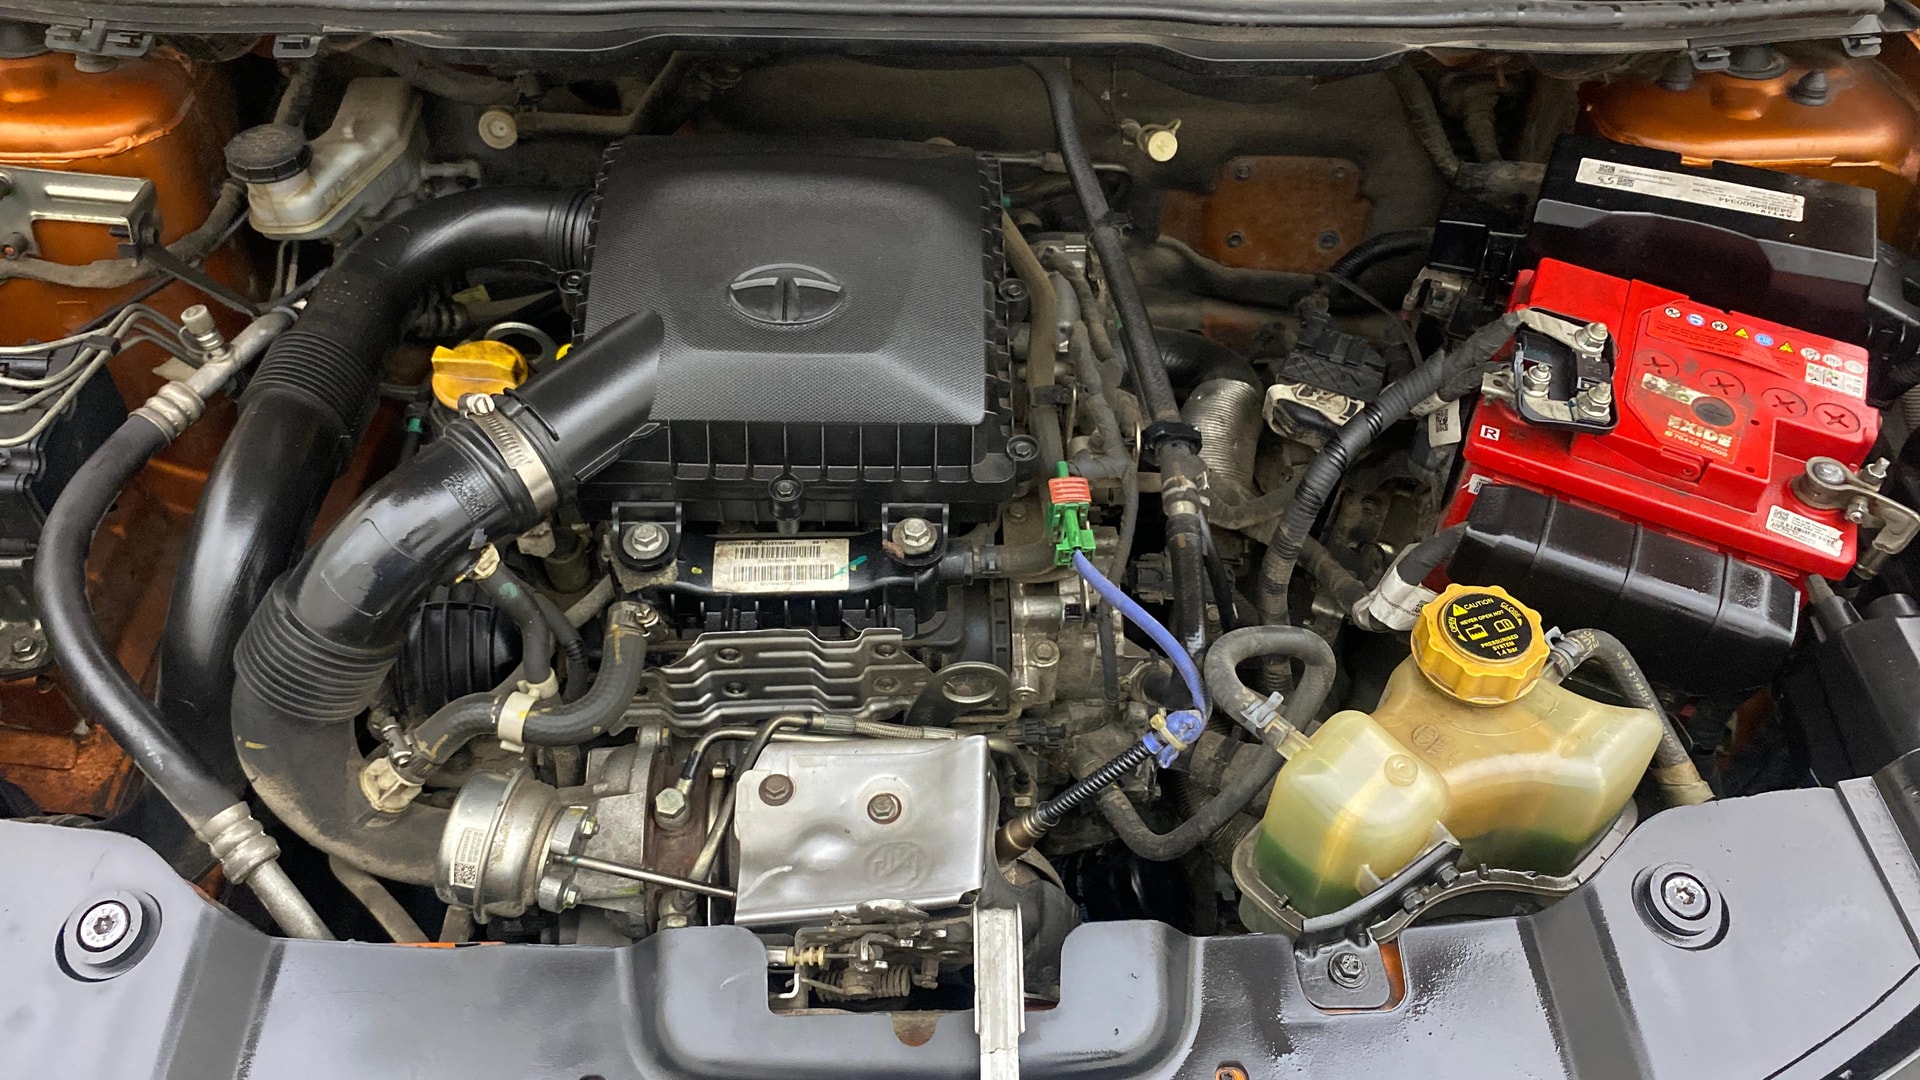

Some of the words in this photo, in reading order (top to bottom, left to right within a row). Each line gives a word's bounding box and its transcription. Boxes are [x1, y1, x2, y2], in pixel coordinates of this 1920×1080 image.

[1484, 428, 1496, 439] R
[1668, 414, 1732, 448] EXIDE
[1463, 597, 1494, 610] CAUTION
[1500, 601, 1521, 618] CLOSE
[1459, 616, 1478, 626] NEVER
[1478, 612, 1493, 621] OPEN
[1492, 609, 1504, 617] HOT
